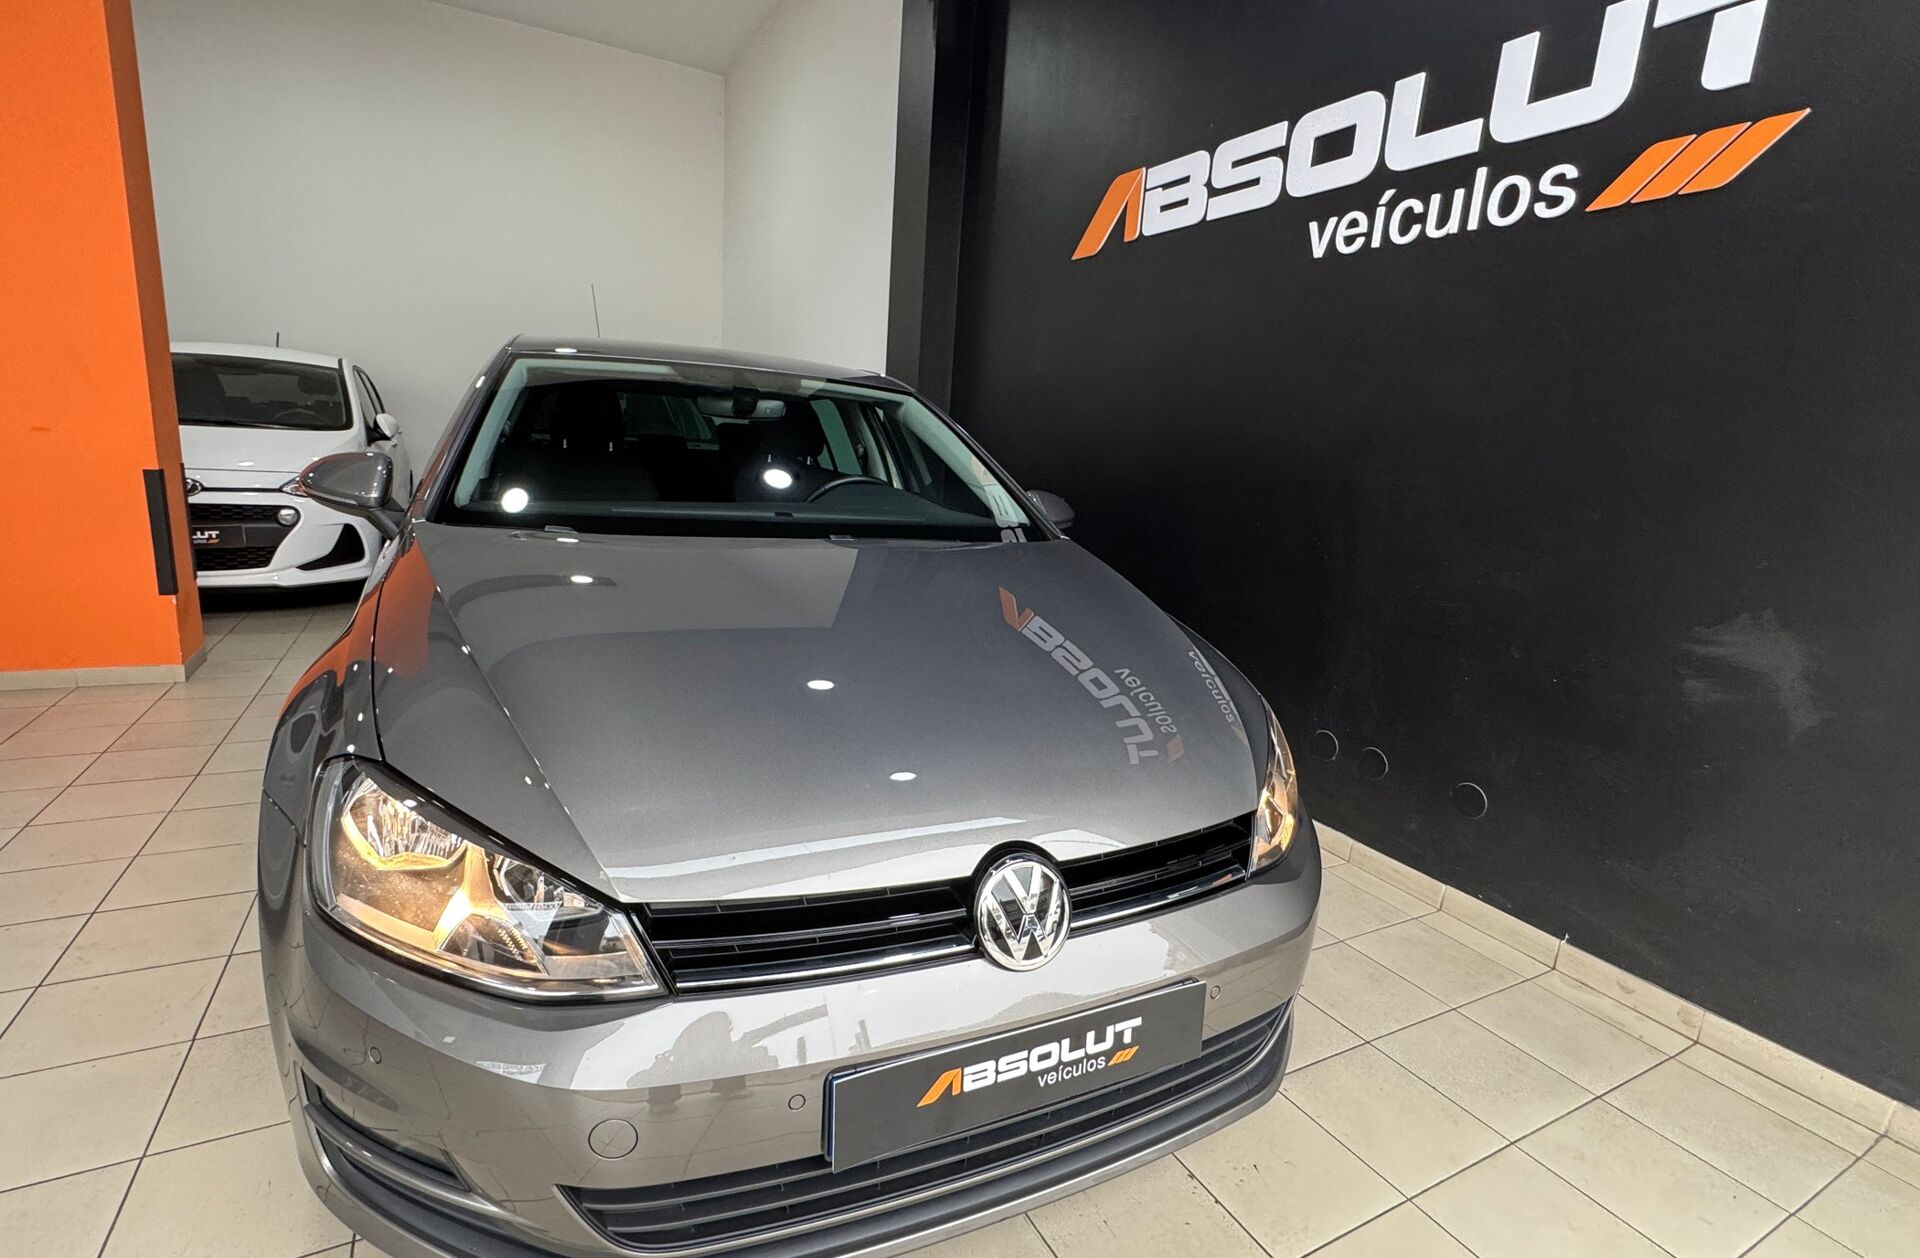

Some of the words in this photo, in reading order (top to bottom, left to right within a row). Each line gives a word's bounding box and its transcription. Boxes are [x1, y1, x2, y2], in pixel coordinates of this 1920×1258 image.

[1309, 164, 1580, 258] veículos
[916, 1016, 1142, 1108] ABSOLUT
[1037, 1055, 1107, 1088] veículos
